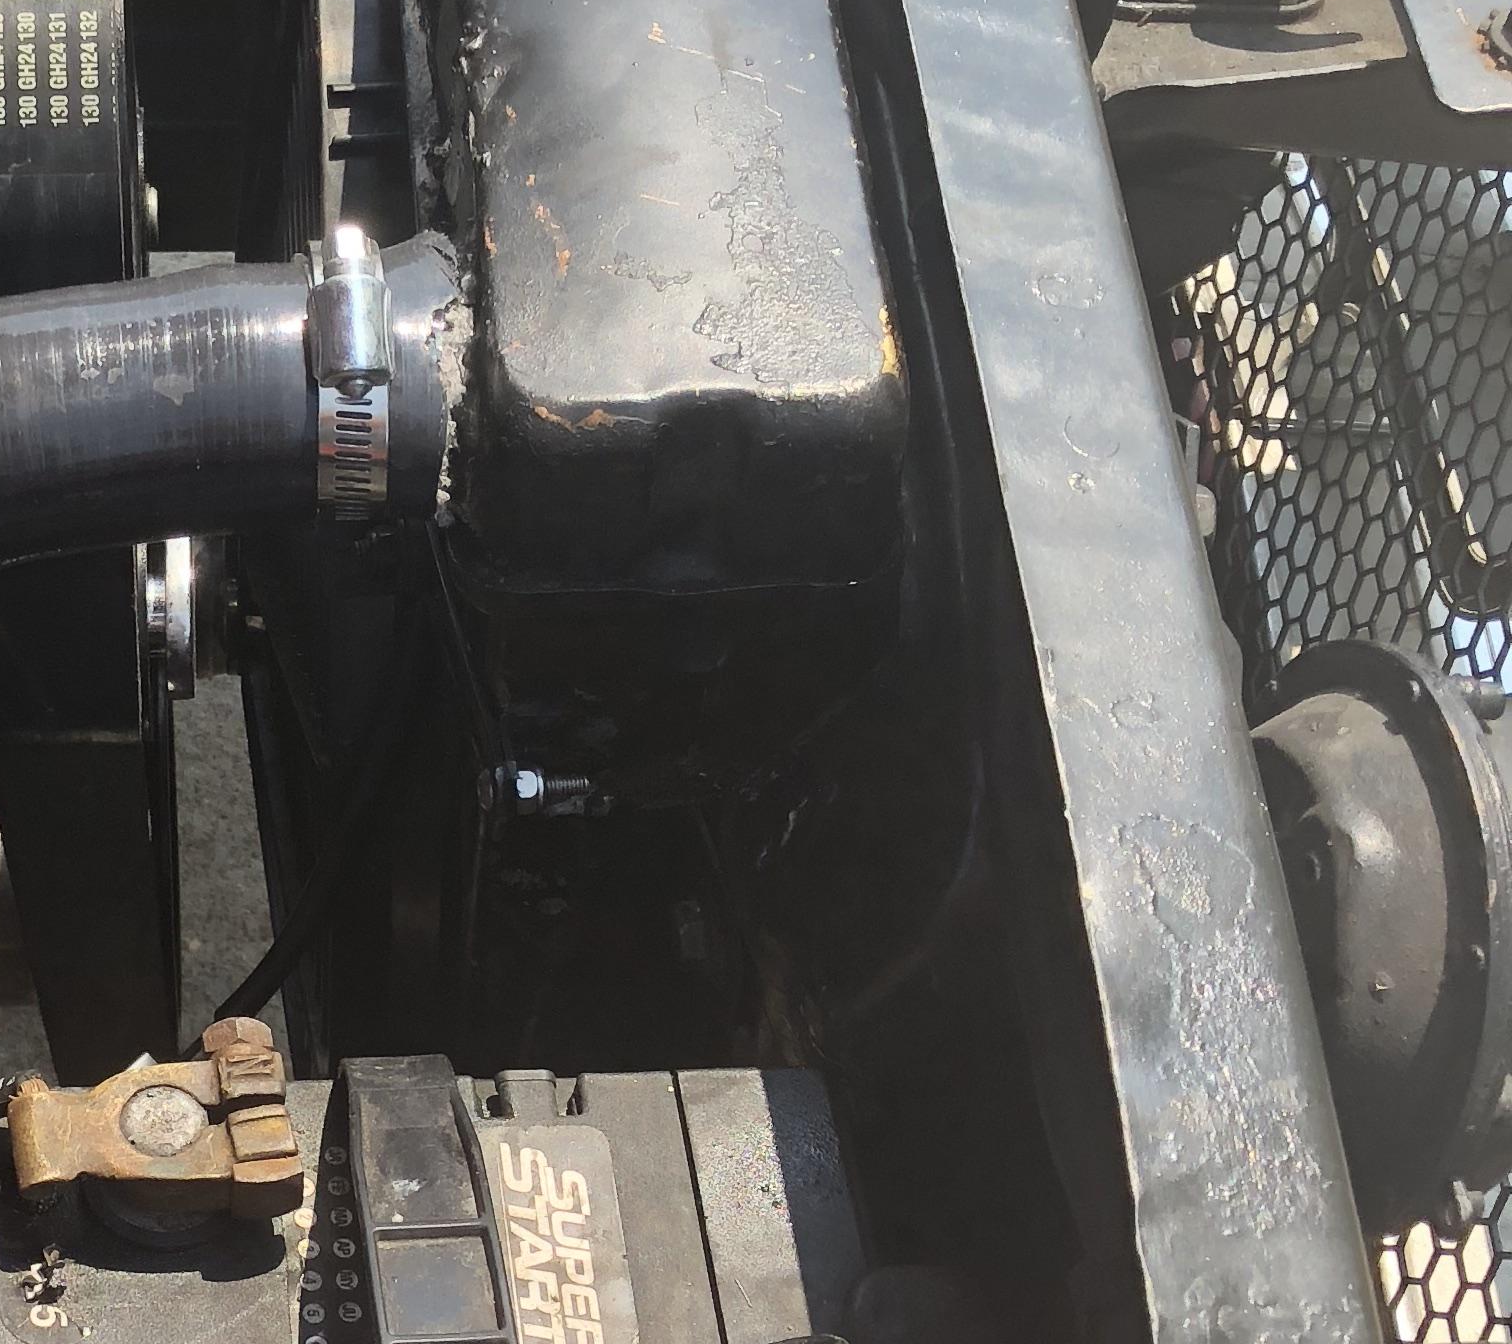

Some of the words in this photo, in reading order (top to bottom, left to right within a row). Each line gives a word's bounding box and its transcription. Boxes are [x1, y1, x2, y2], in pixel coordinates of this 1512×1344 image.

[17, 11, 36, 42] 130
[48, 13, 67, 42] 131
[79, 10, 98, 41] 132
[17, 43, 37, 90] GH24
[49, 42, 68, 89] GH24
[80, 42, 99, 89] GH24
[18, 96, 37, 128] 130
[50, 94, 68, 127] 130
[81, 94, 100, 127] 130
